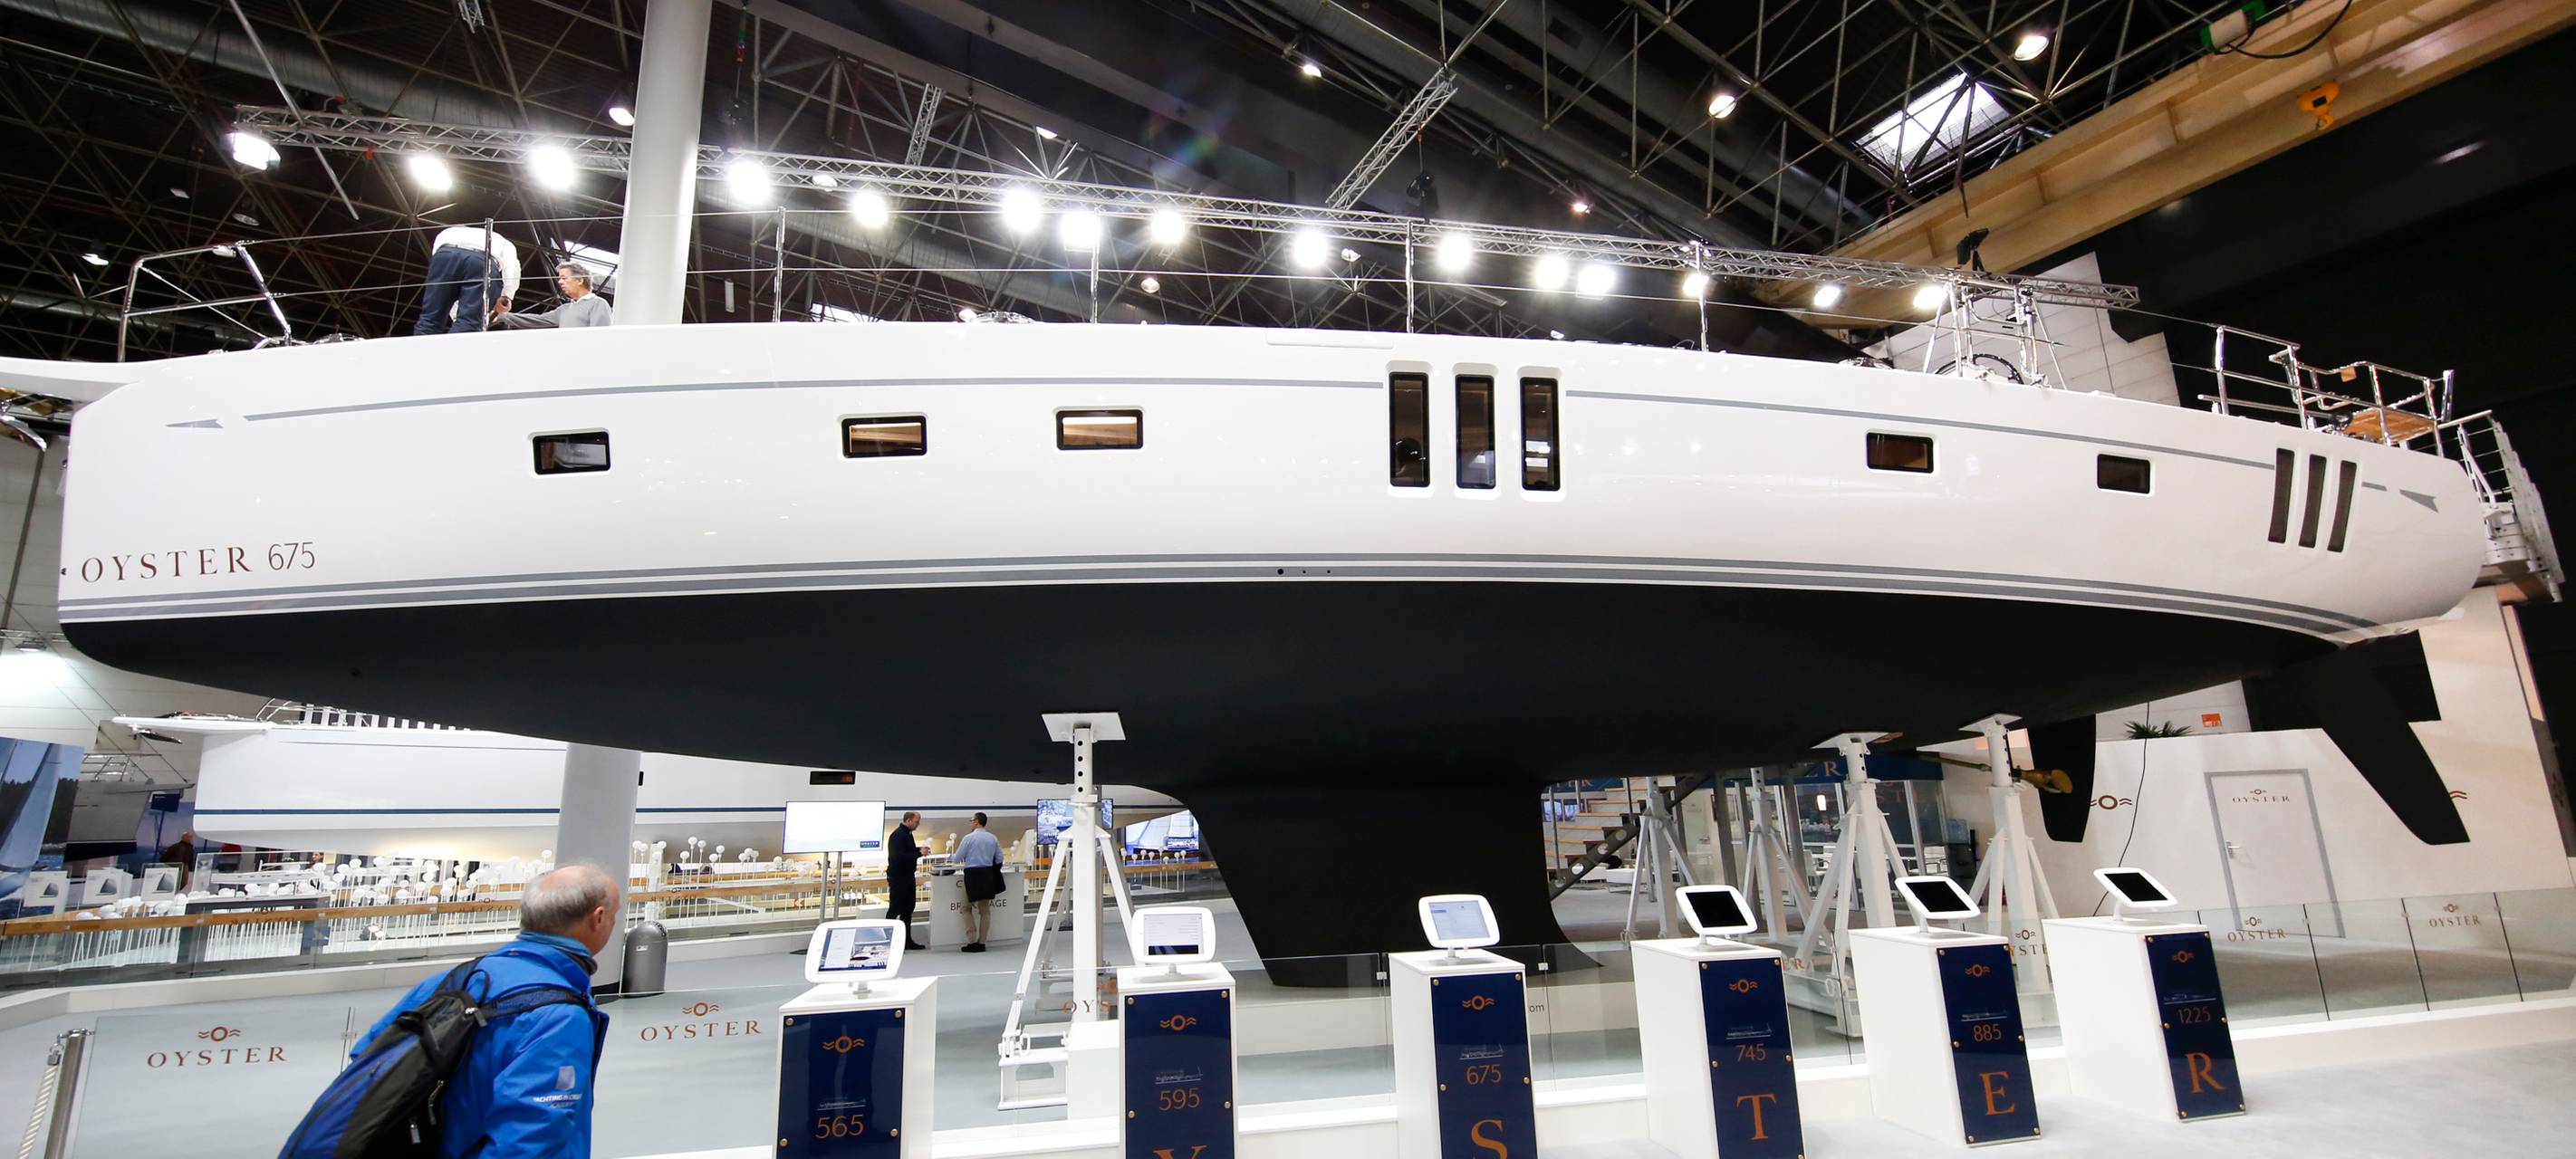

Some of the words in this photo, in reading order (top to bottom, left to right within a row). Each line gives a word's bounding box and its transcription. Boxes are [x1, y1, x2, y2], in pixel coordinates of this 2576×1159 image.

[81, 545, 255, 584] OYSTER
[268, 541, 316, 571] 675
[2428, 915, 2480, 928] OYSTER
[2227, 928, 2286, 943] OYSTER
[2178, 1006, 2211, 1024] 1225
[640, 1020, 762, 1041] OYSTER
[1973, 1023, 2002, 1042] 885
[147, 1046, 287, 1068] OYSTER
[1735, 1043, 1766, 1062] 745
[1466, 1064, 1502, 1085] 675
[2185, 1052, 2226, 1093] R
[1159, 1087, 1200, 1111] 595
[1979, 1071, 2015, 1116] E
[815, 1114, 864, 1139] 565
[1736, 1093, 1776, 1140] T
[1471, 1119, 1508, 1159] S
